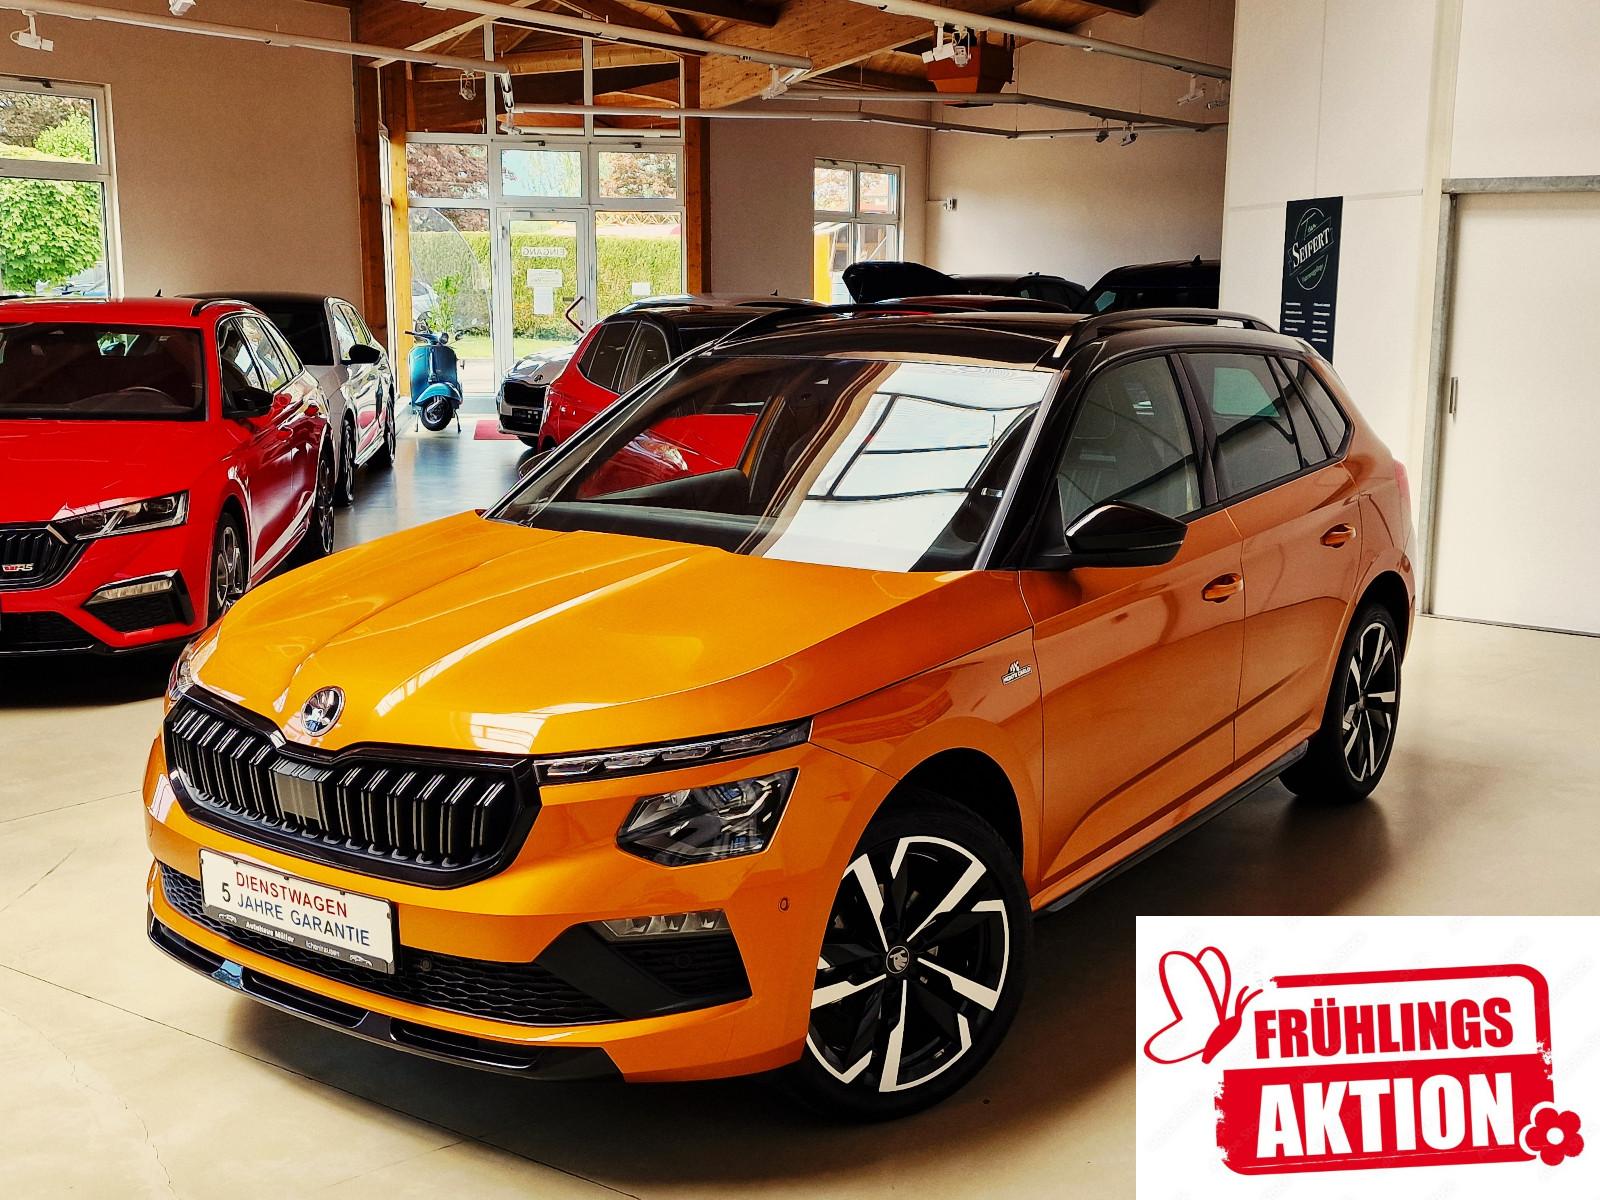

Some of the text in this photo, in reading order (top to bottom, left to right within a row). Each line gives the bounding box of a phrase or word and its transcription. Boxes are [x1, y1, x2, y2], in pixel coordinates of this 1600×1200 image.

[222, 882, 370, 946] 5 JAHRE GARANTIE
[236, 871, 347, 918] DIENSTWAGEN
